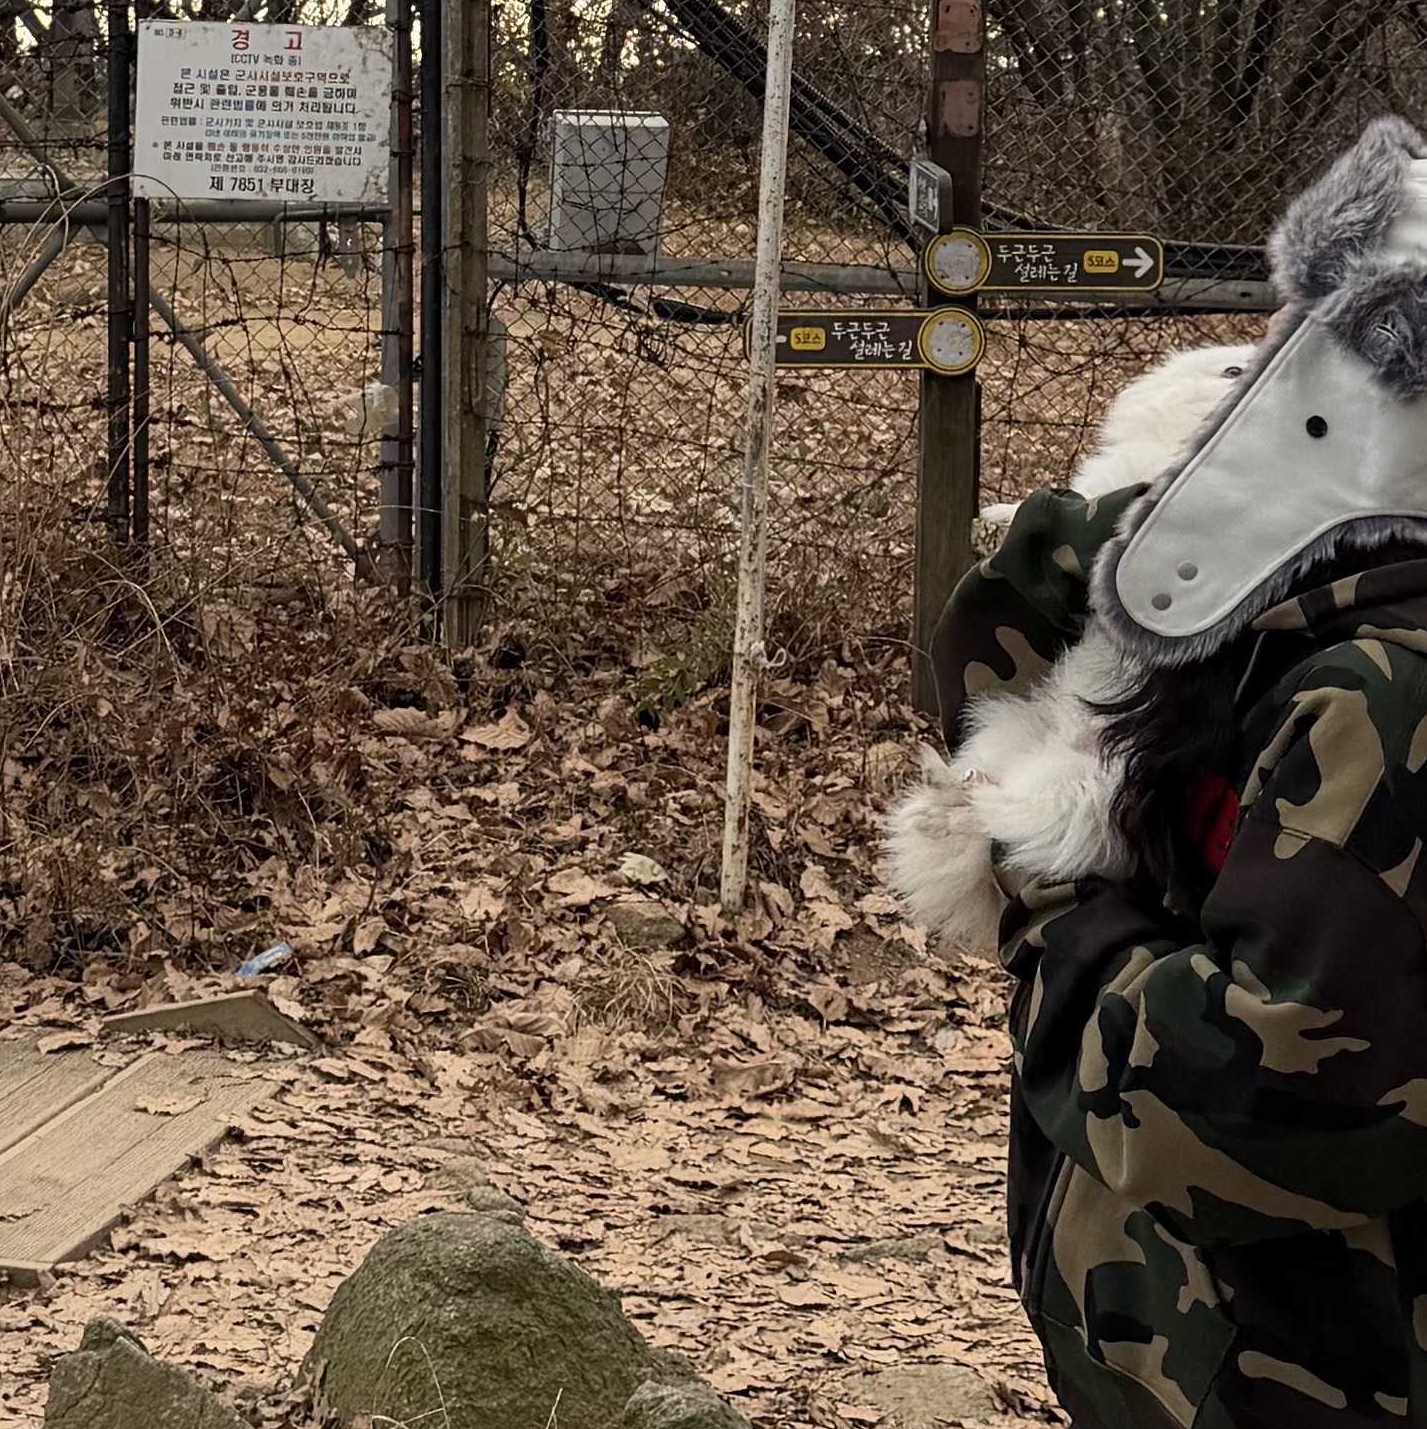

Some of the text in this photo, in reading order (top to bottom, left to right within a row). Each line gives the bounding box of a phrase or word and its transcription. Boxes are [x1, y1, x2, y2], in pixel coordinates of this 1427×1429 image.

[232, 29, 302, 50] 경 고
[264, 55, 283, 65] 녹화
[181, 68, 349, 84] 본 시설은 군사시설보호구역으로
[173, 83, 195, 94] 접근
[200, 83, 210, 95] 및
[216, 84, 241, 96] 출입,
[285, 87, 317, 99] 훼손을
[323, 87, 356, 99] 금하며
[170, 97, 204, 109] 위반시
[210, 99, 266, 111] 관련법률에
[272, 101, 293, 112] 의거
[210, 176, 314, 193] 제 7851 부대장
[996, 244, 1055, 263] 두근두근
[1015, 262, 1078, 283] 설레는 길
[832, 322, 890, 340] 두근두근
[850, 339, 913, 360] 설레는 길
